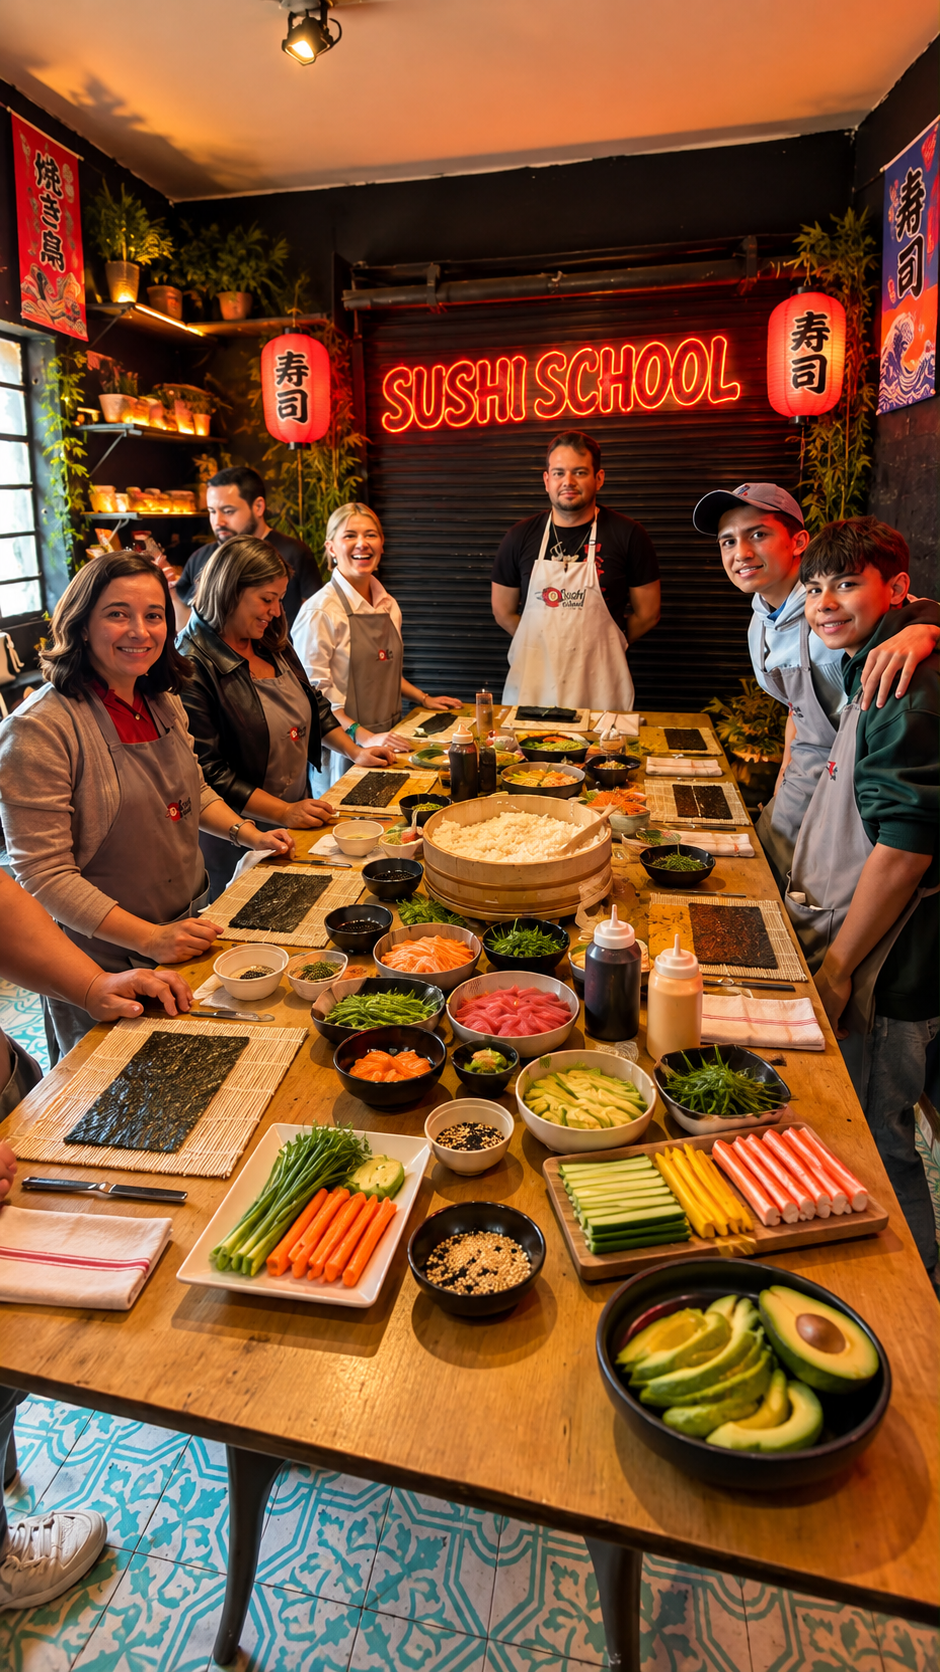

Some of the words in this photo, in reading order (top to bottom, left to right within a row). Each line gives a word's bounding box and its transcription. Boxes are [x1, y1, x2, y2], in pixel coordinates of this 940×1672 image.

[897, 168, 925, 298] 寿司
[275, 350, 310, 424] 寿司
[382, 355, 527, 433] SUSHI
[534, 336, 741, 418] SCHOOL
[791, 310, 831, 395] 寿司
